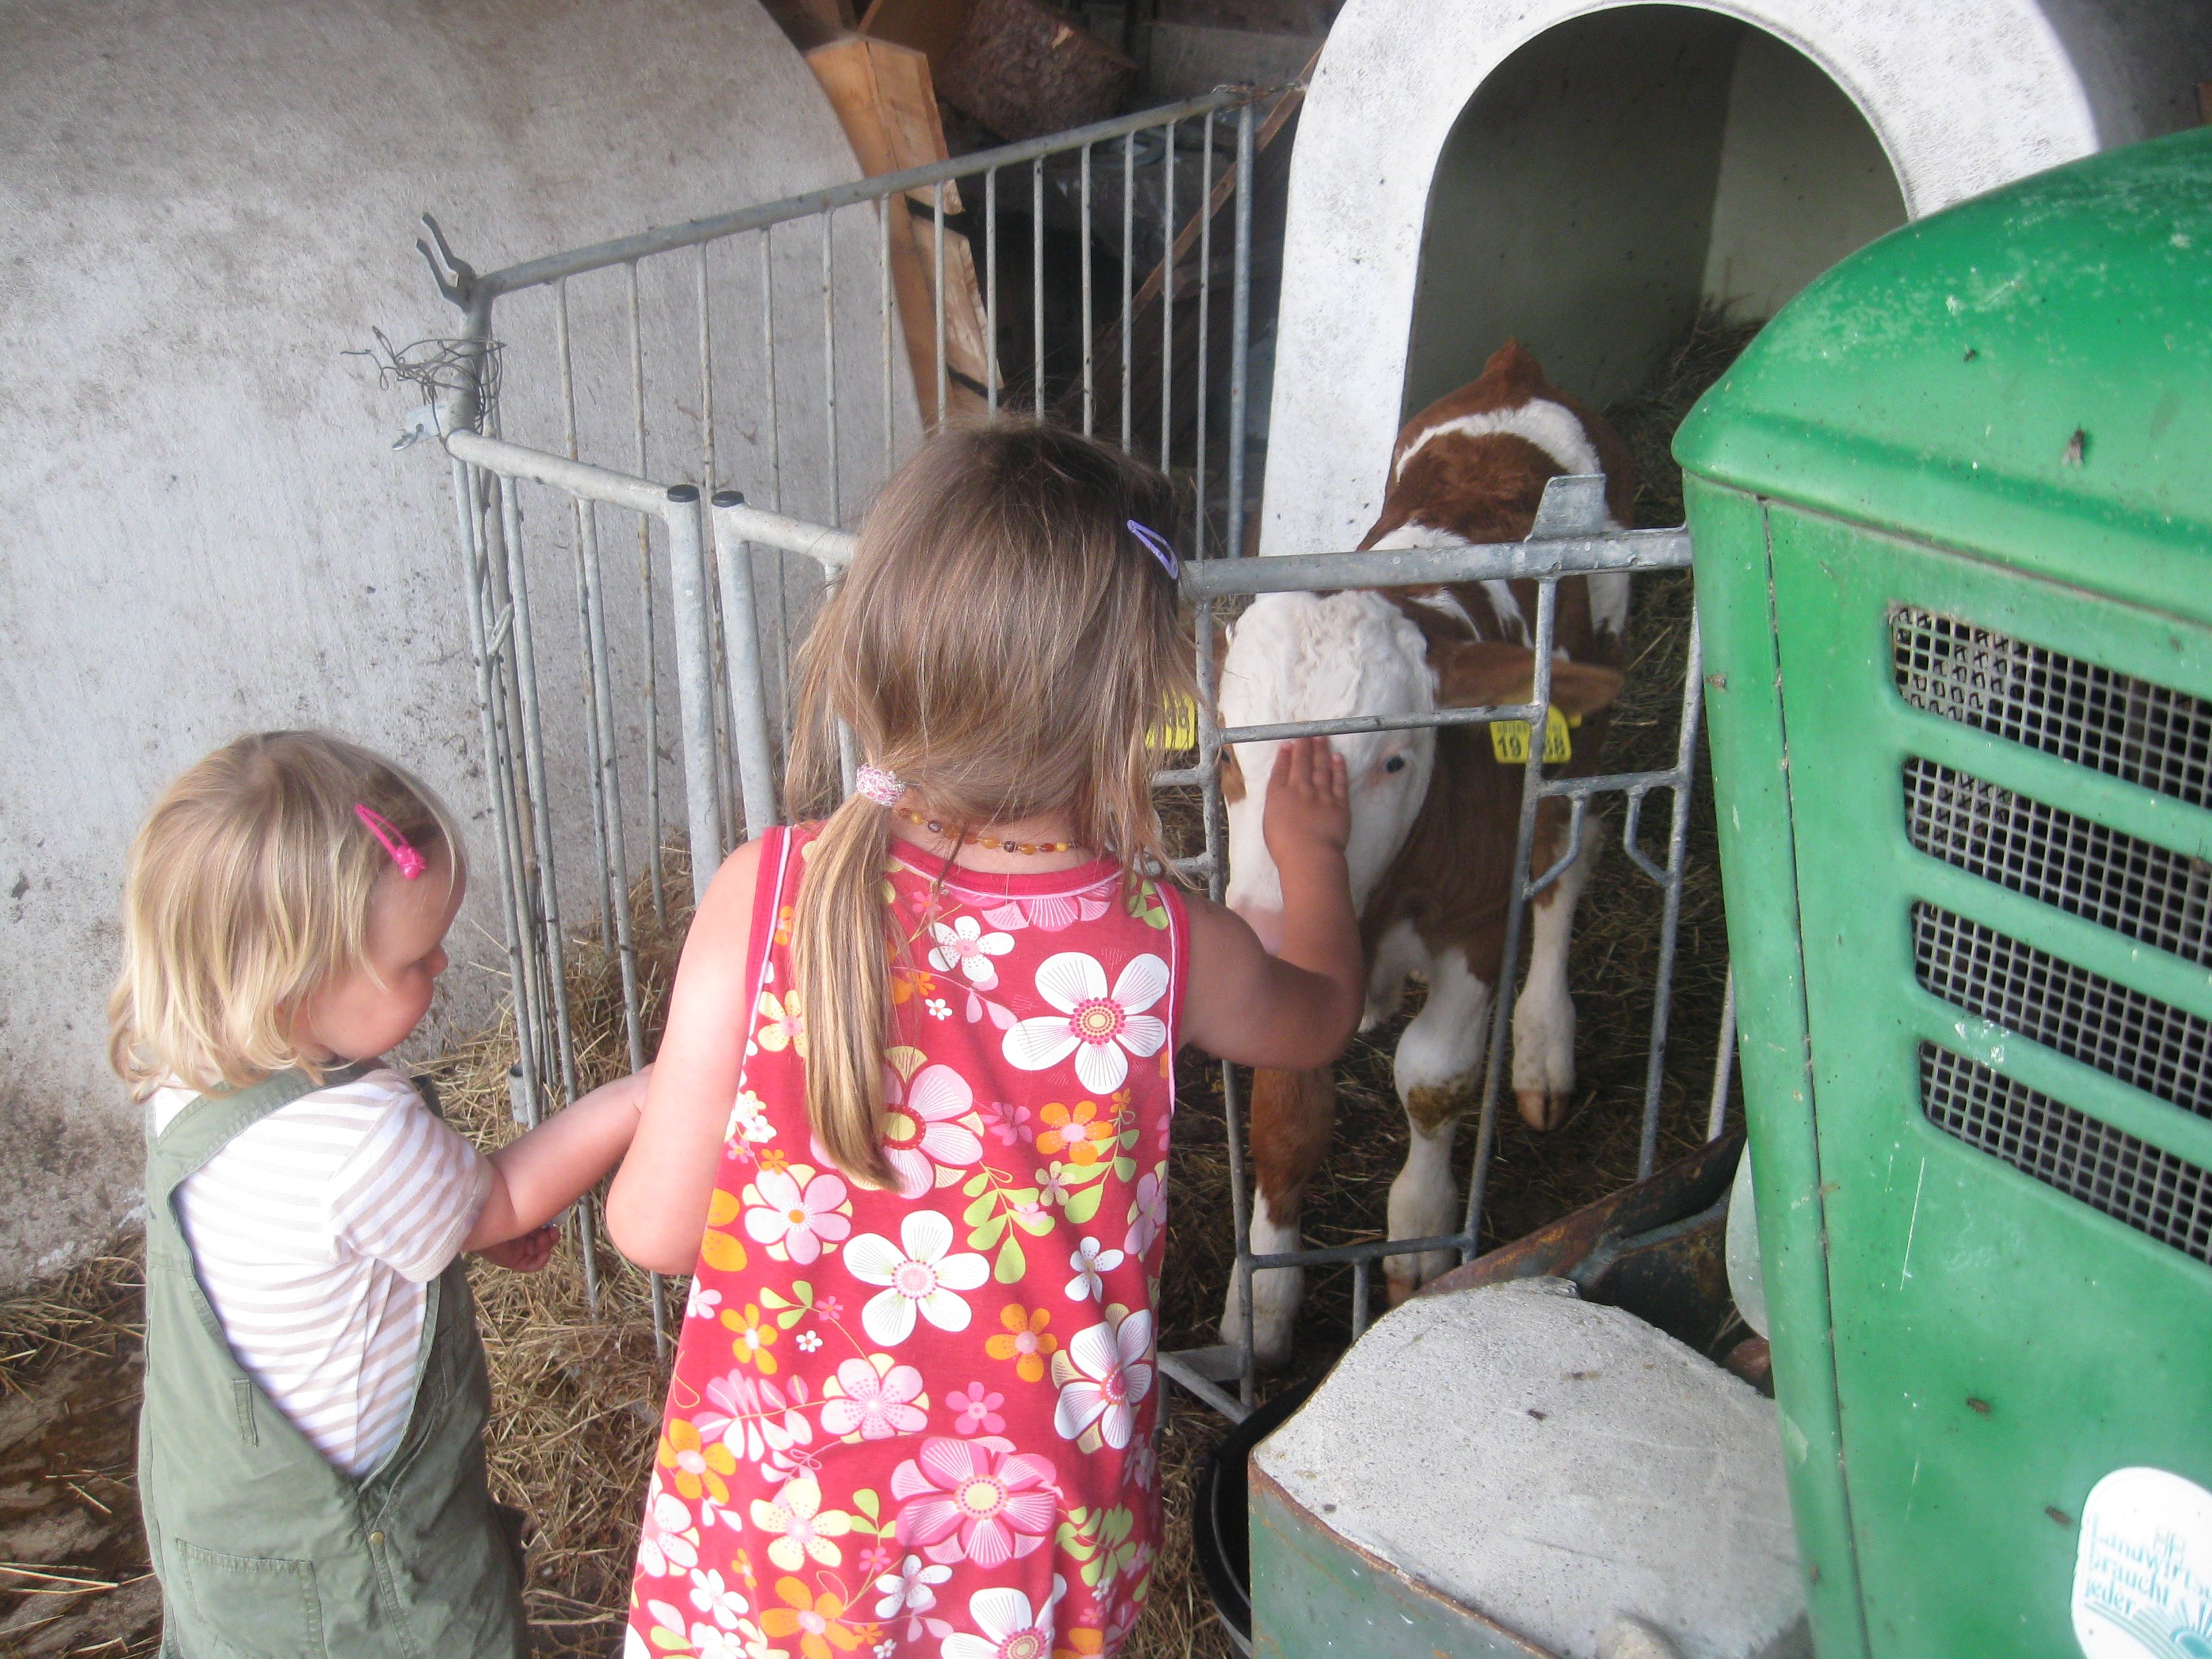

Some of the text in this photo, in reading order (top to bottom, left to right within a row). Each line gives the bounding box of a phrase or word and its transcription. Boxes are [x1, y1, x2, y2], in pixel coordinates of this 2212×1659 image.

[1498, 736, 1522, 757] 19
[2084, 1577, 2136, 1616] jeder
[2089, 1547, 2171, 1607] braucht
